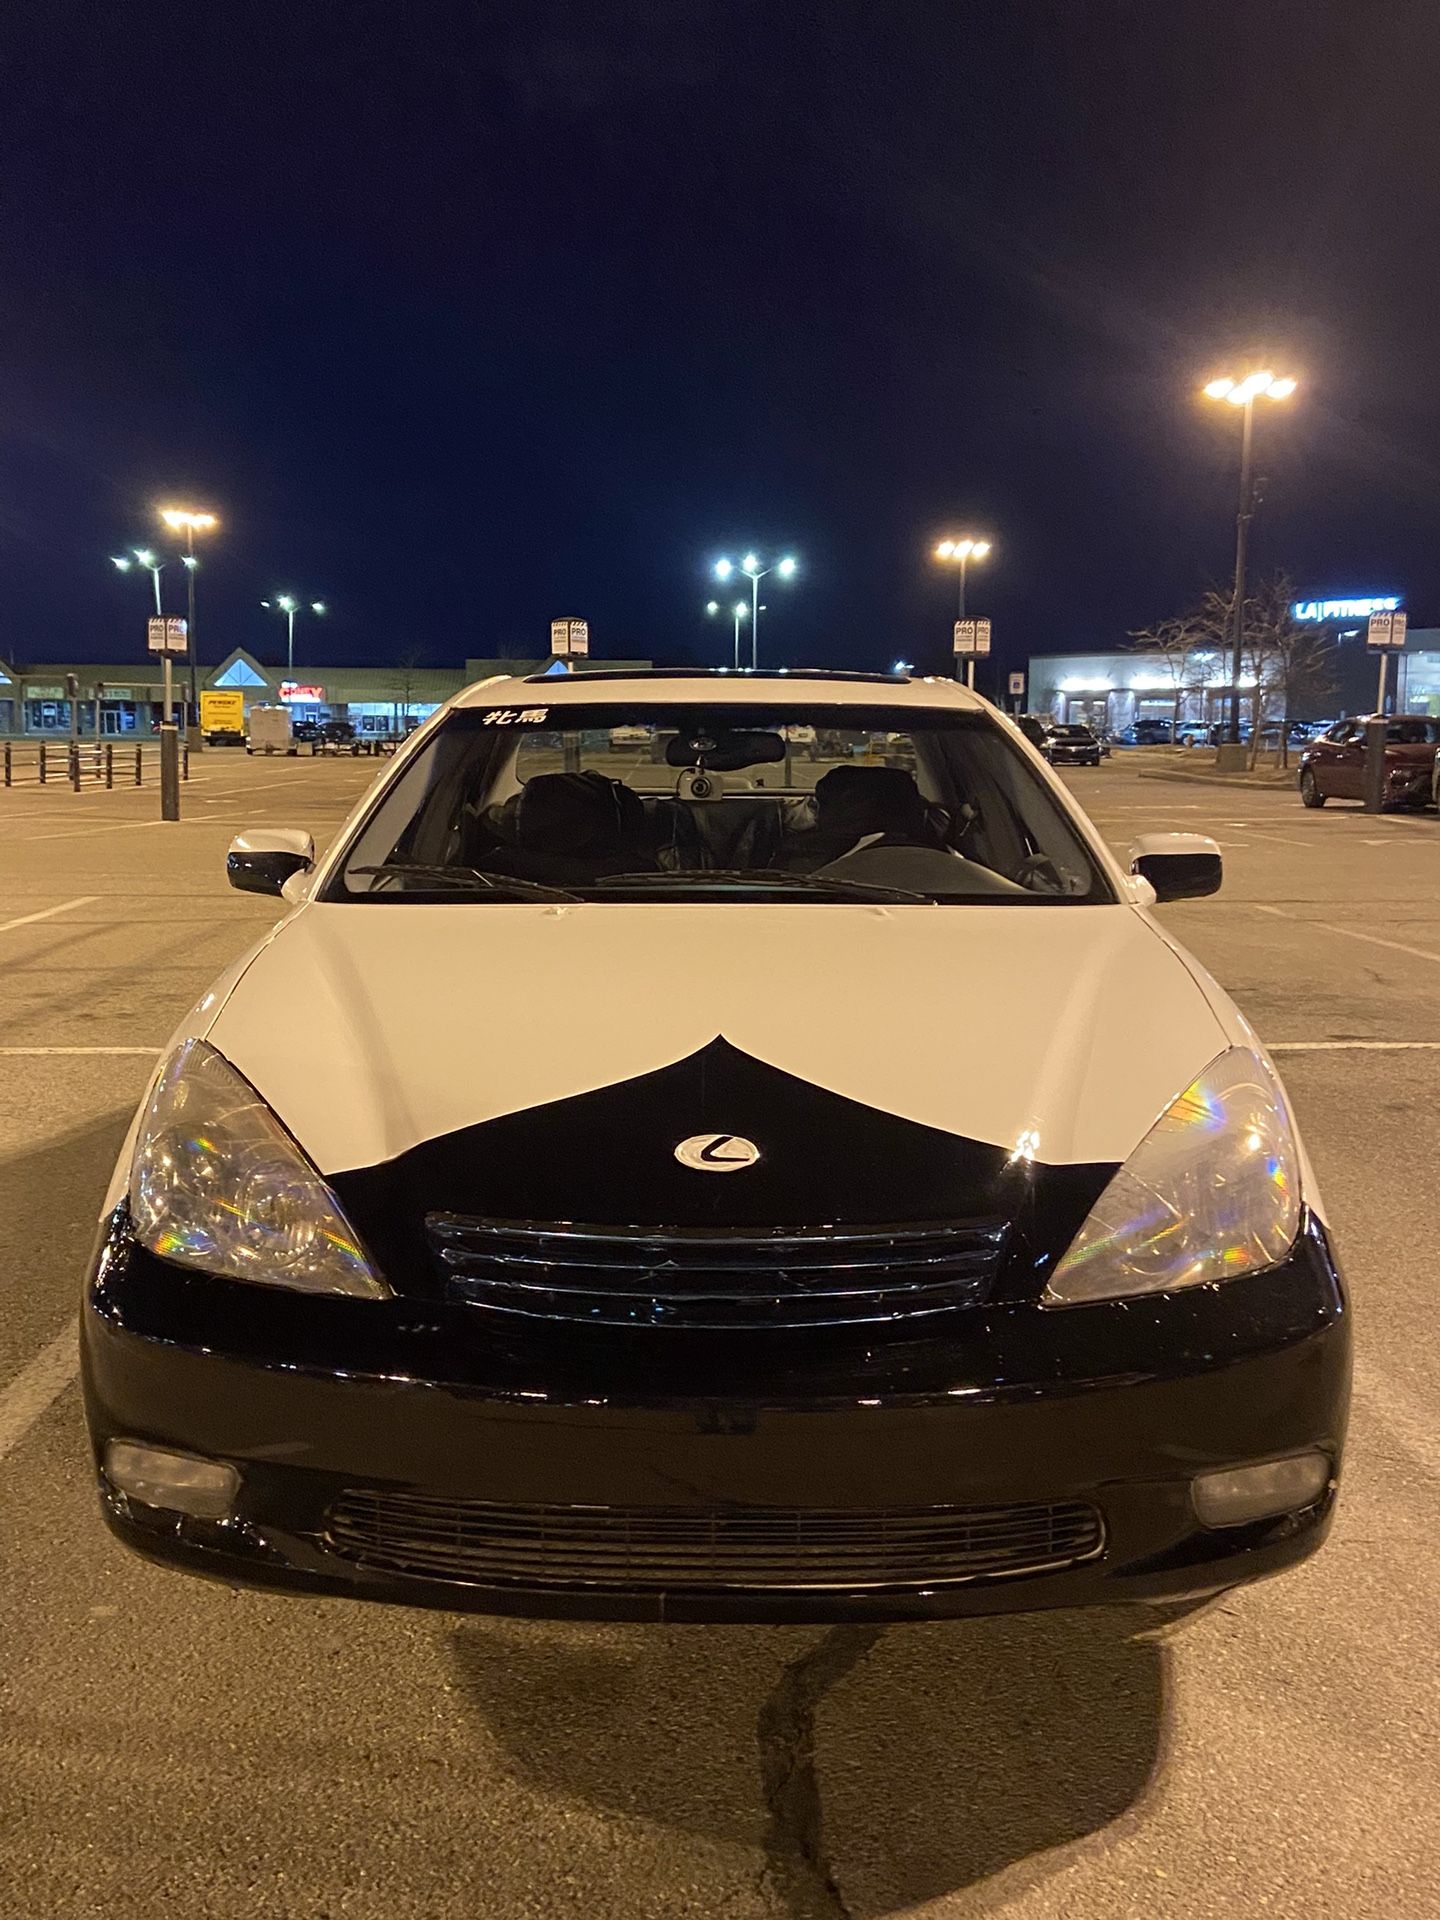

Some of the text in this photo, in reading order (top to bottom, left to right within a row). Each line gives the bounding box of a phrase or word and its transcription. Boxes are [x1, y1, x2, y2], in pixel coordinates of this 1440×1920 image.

[1295, 602, 1317, 620] LA
[1371, 618, 1390, 626] PRO
[150, 624, 164, 632] PRO
[553, 628, 566, 636] PRO
[571, 627, 586, 636] PRO
[956, 627, 973, 635] PRO
